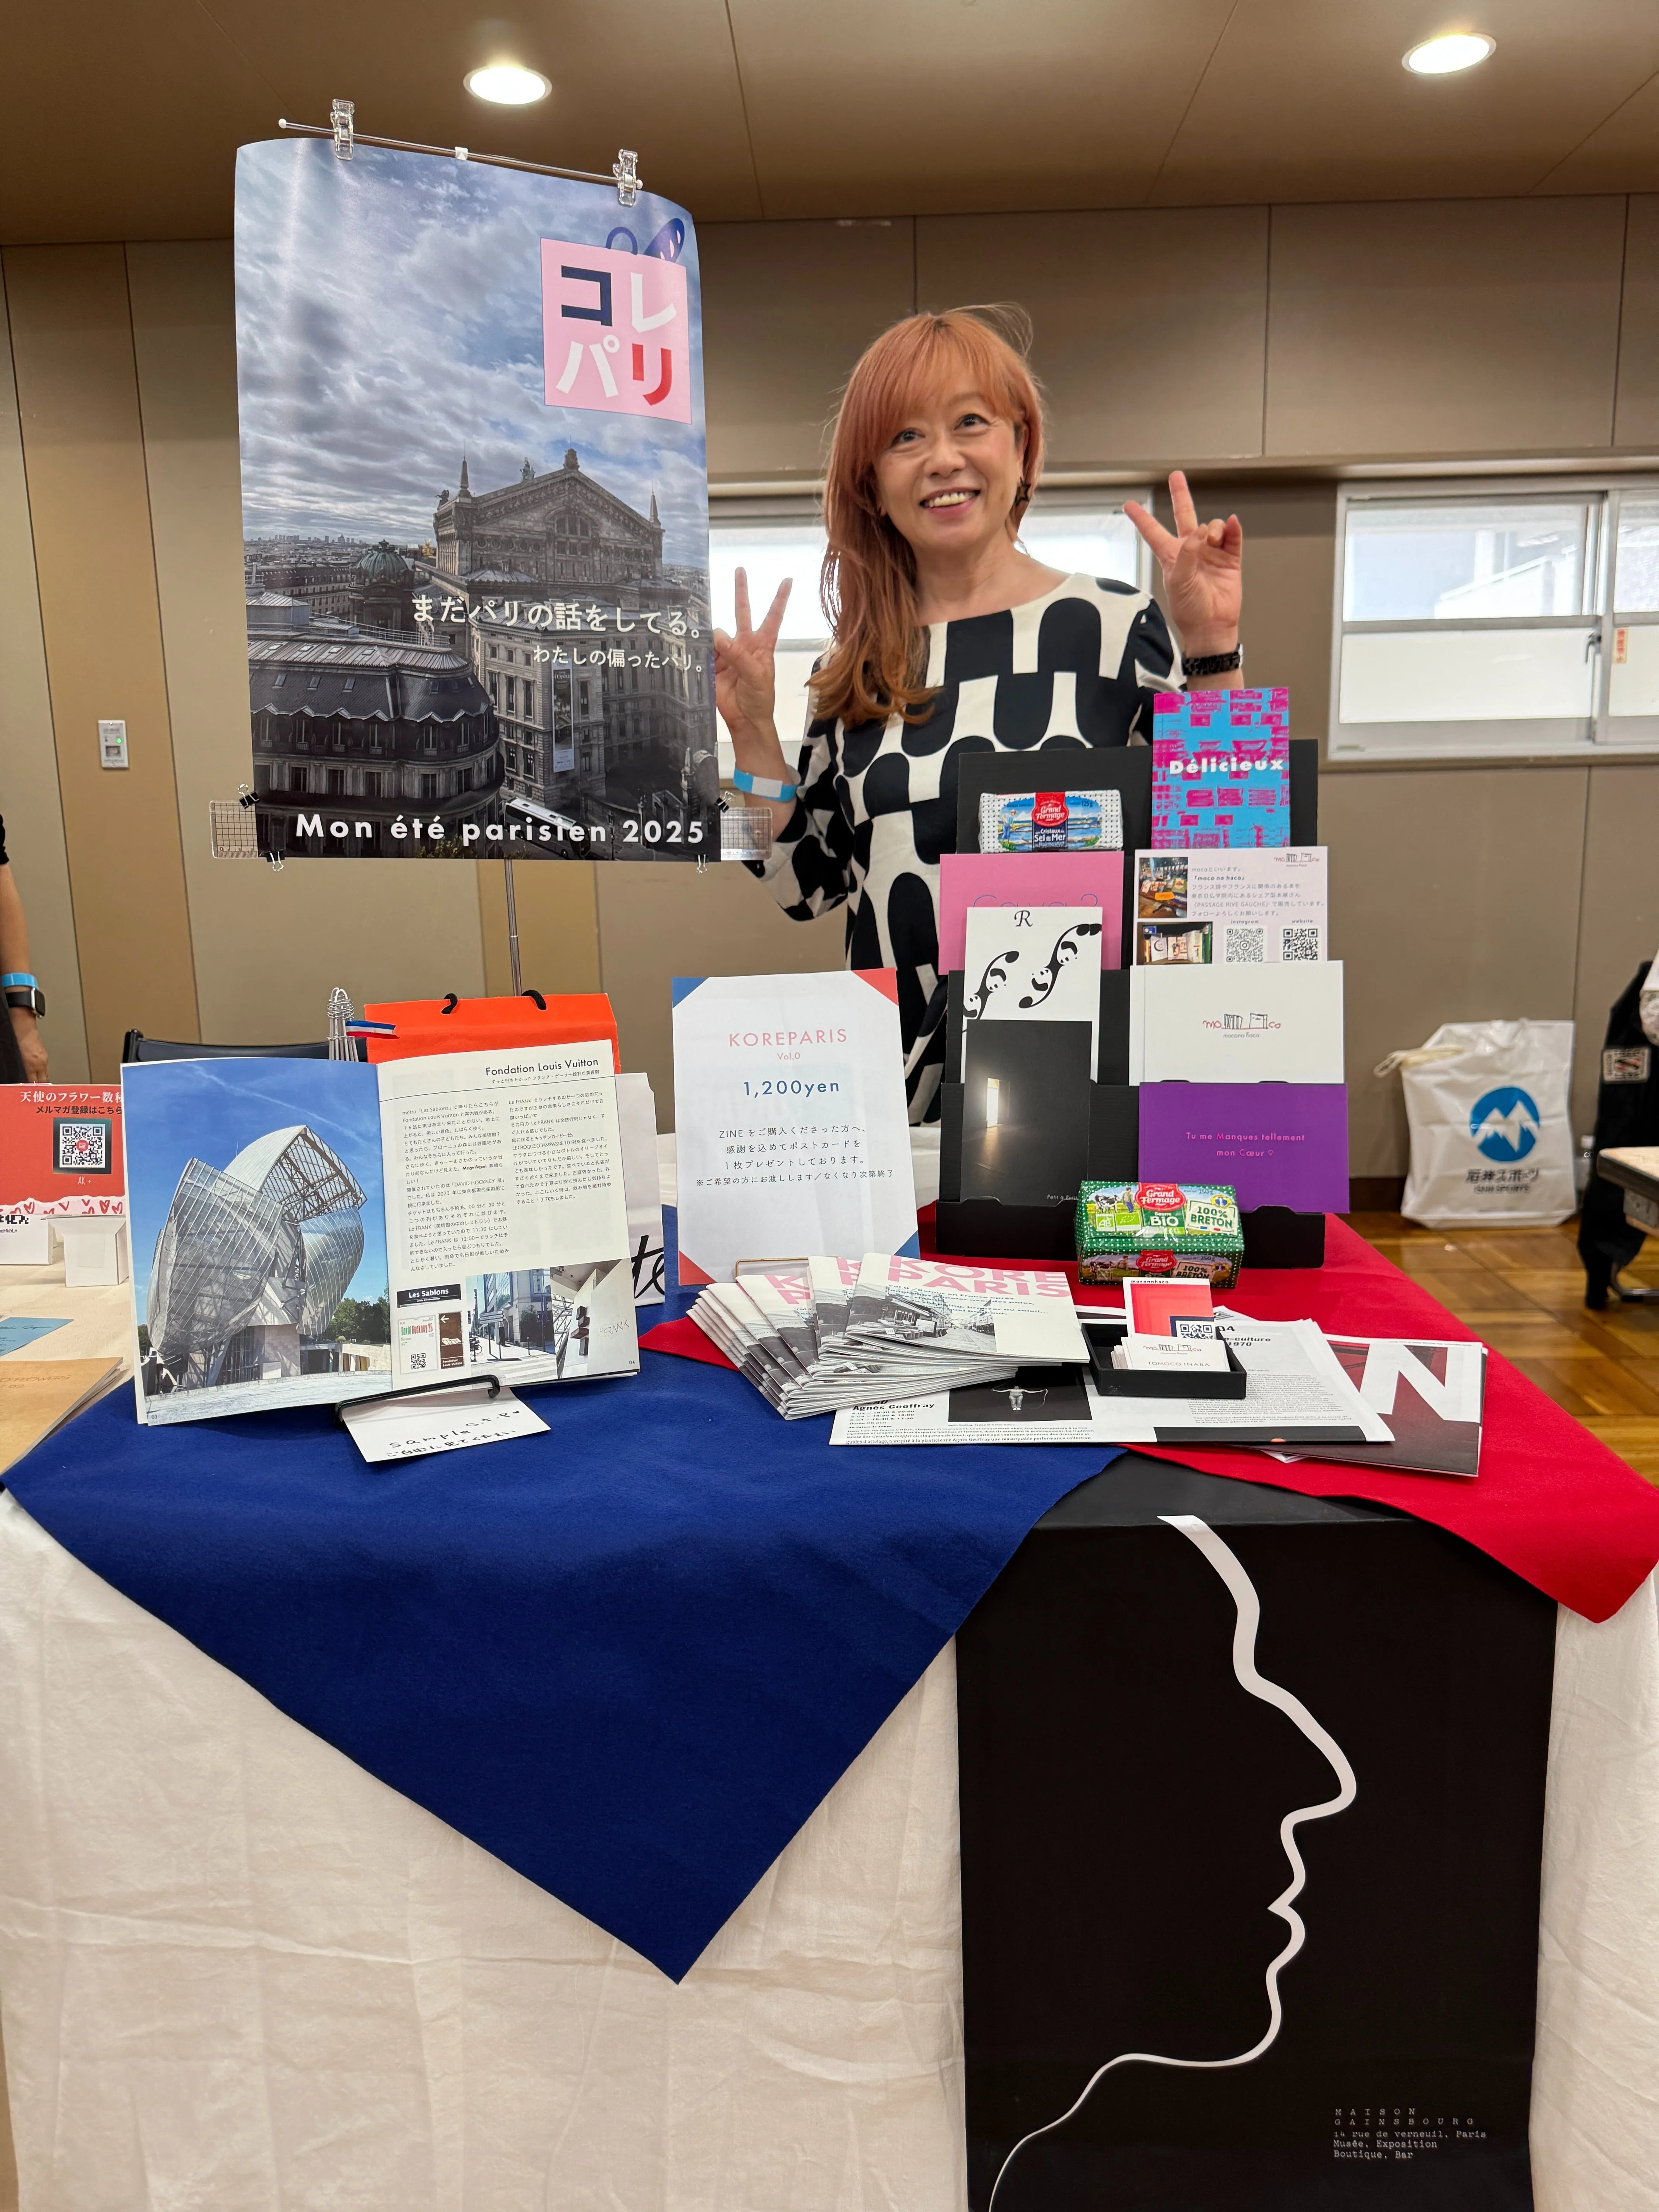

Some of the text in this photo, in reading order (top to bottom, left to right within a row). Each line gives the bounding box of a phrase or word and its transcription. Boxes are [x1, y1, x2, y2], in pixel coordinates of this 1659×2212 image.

[562, 265, 677, 333] コレ
[556, 335, 672, 405] パリ
[412, 595, 699, 639] まだパリの話をしてる。
[534, 644, 702, 672] わたしの偏ったパリ。
[1170, 757, 1283, 774] Délicieux
[1041, 805, 1061, 813] Grand
[296, 814, 704, 847] Mon été parisien 2025
[1014, 910, 1032, 927] R
[729, 1028, 847, 1048] KOREPARIS
[776, 1052, 800, 1061] Vol.0
[486, 1059, 598, 1075] Fondation Louis Vuitton
[743, 1080, 840, 1099] 1,200yen
[719, 1128, 744, 1139] ZINE
[1216, 1133, 1257, 1142] Manques
[726, 1139, 861, 1154] 感謝を込めてポストカードを
[1140, 1196, 1180, 1204] Fermage
[1197, 1206, 1228, 1218] 100%
[1191, 1214, 1232, 1229] BRETON
[890, 1255, 1068, 1282] KORE
[888, 1267, 1070, 1297] PARIS
[422, 1288, 449, 1297] Sablons
[401, 1324, 427, 1335] David Hockney
[390, 1430, 471, 1448] Sample
[1334, 2140, 1437, 2149] Musée, Exposition
[1334, 2150, 1413, 2160] Boutique, Bar
